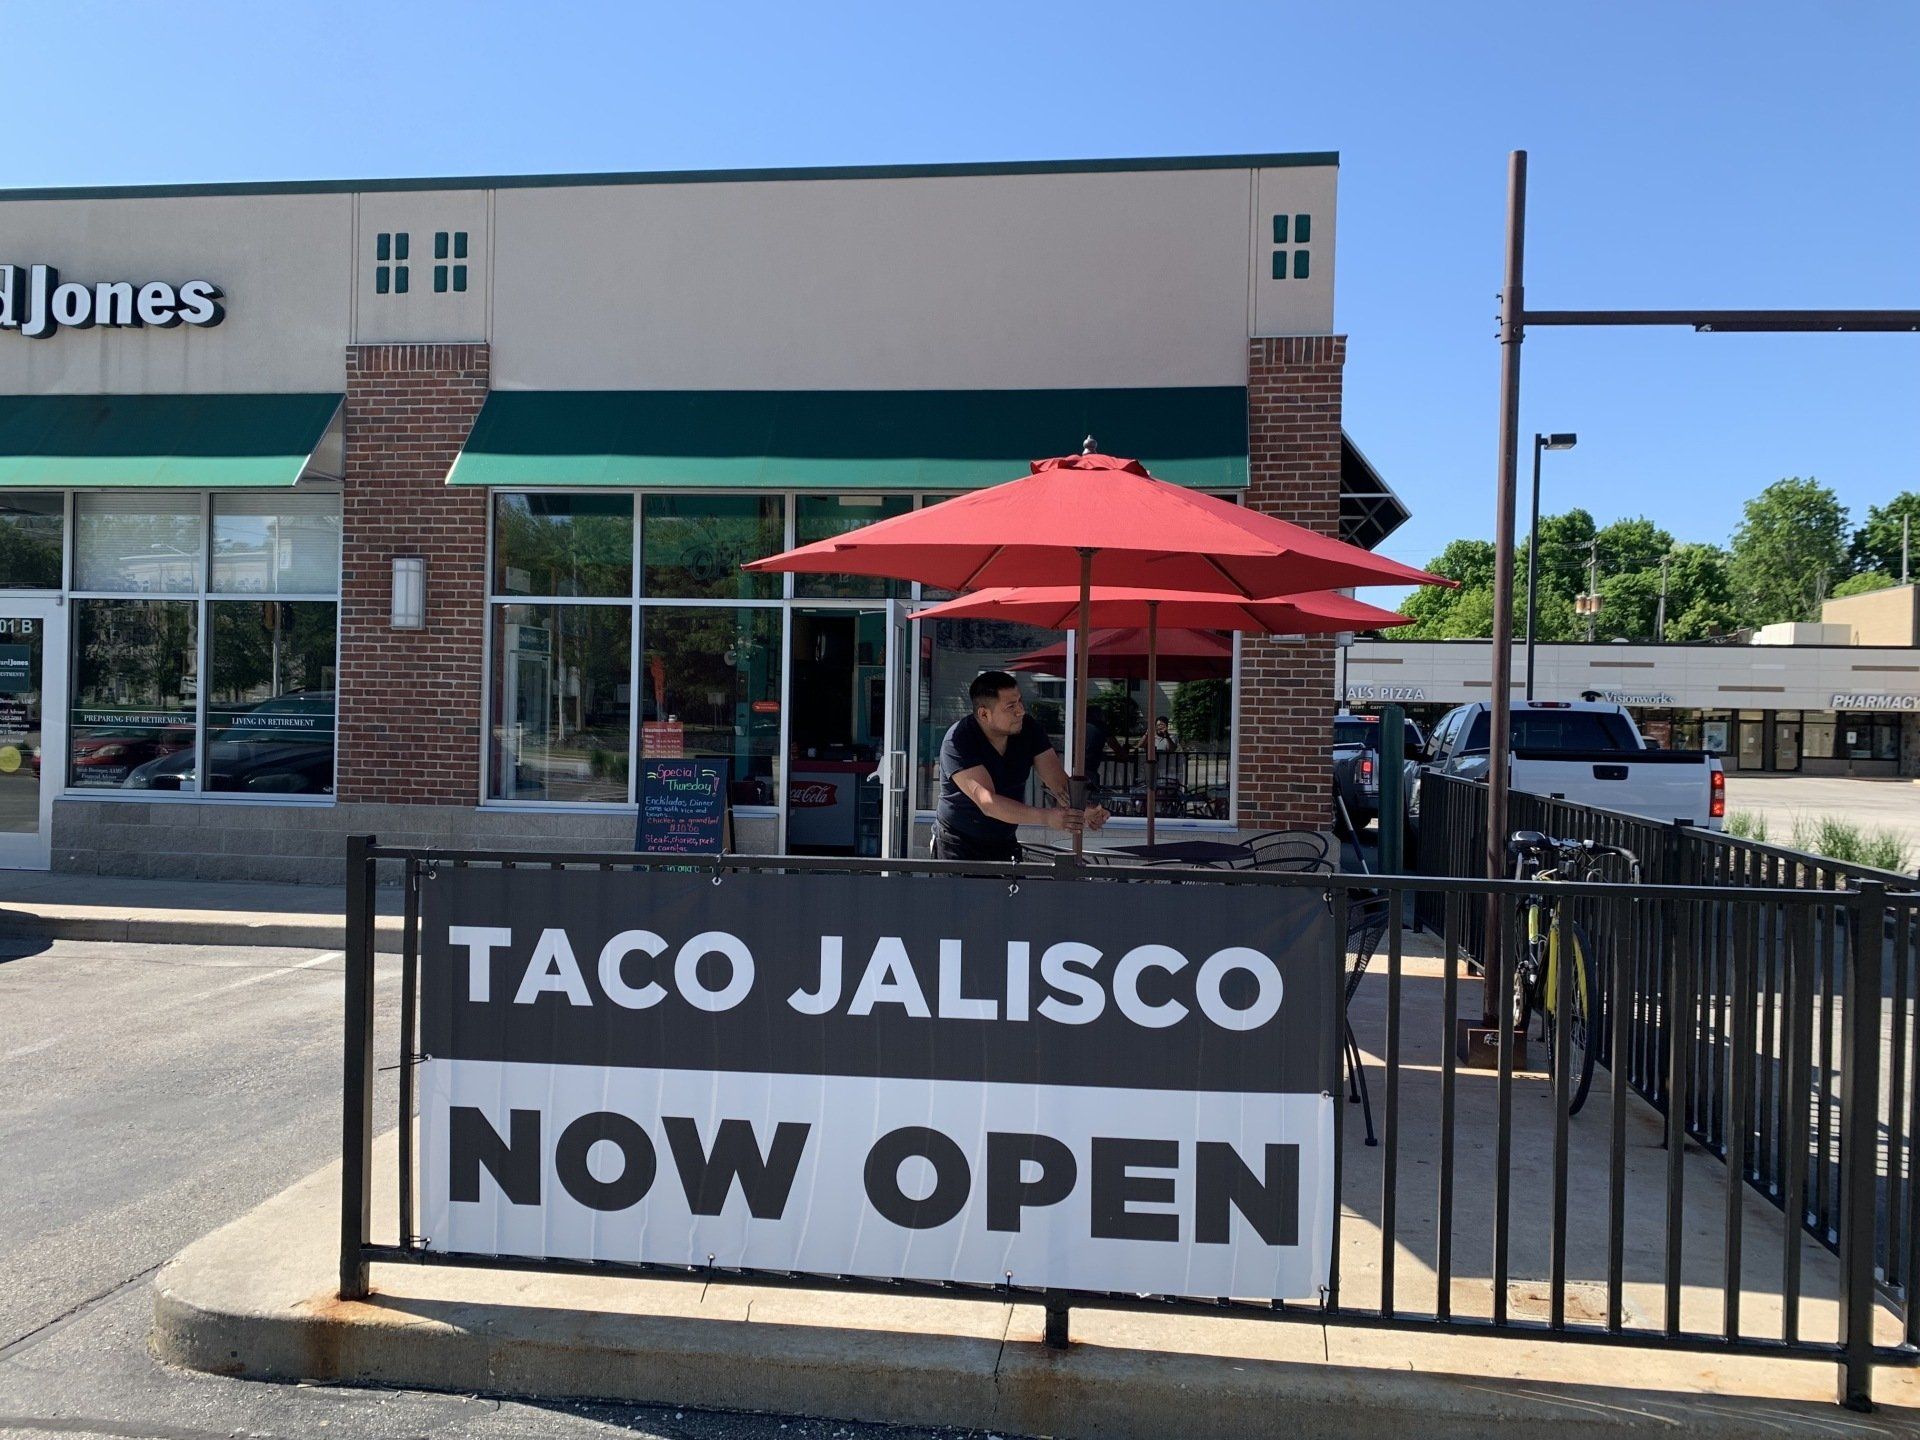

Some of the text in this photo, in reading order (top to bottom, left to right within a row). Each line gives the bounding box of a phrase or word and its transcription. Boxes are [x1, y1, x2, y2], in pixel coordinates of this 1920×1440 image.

[22, 619, 33, 633] B
[1340, 687, 1425, 700] AL'S PIZZA
[1604, 691, 1674, 704] Visionworks
[1831, 694, 1920, 709] PHARMACY
[84, 714, 124, 723] PREPARING
[141, 717, 188, 725] RETIREMENT
[231, 717, 257, 725] LIVING
[268, 718, 315, 727] RETIREMENT
[656, 763, 698, 786] Special
[689, 798, 714, 807] Dinner
[448, 925, 1285, 1032] TACO JALISCO
[448, 1105, 1300, 1247] NOW OPEN
